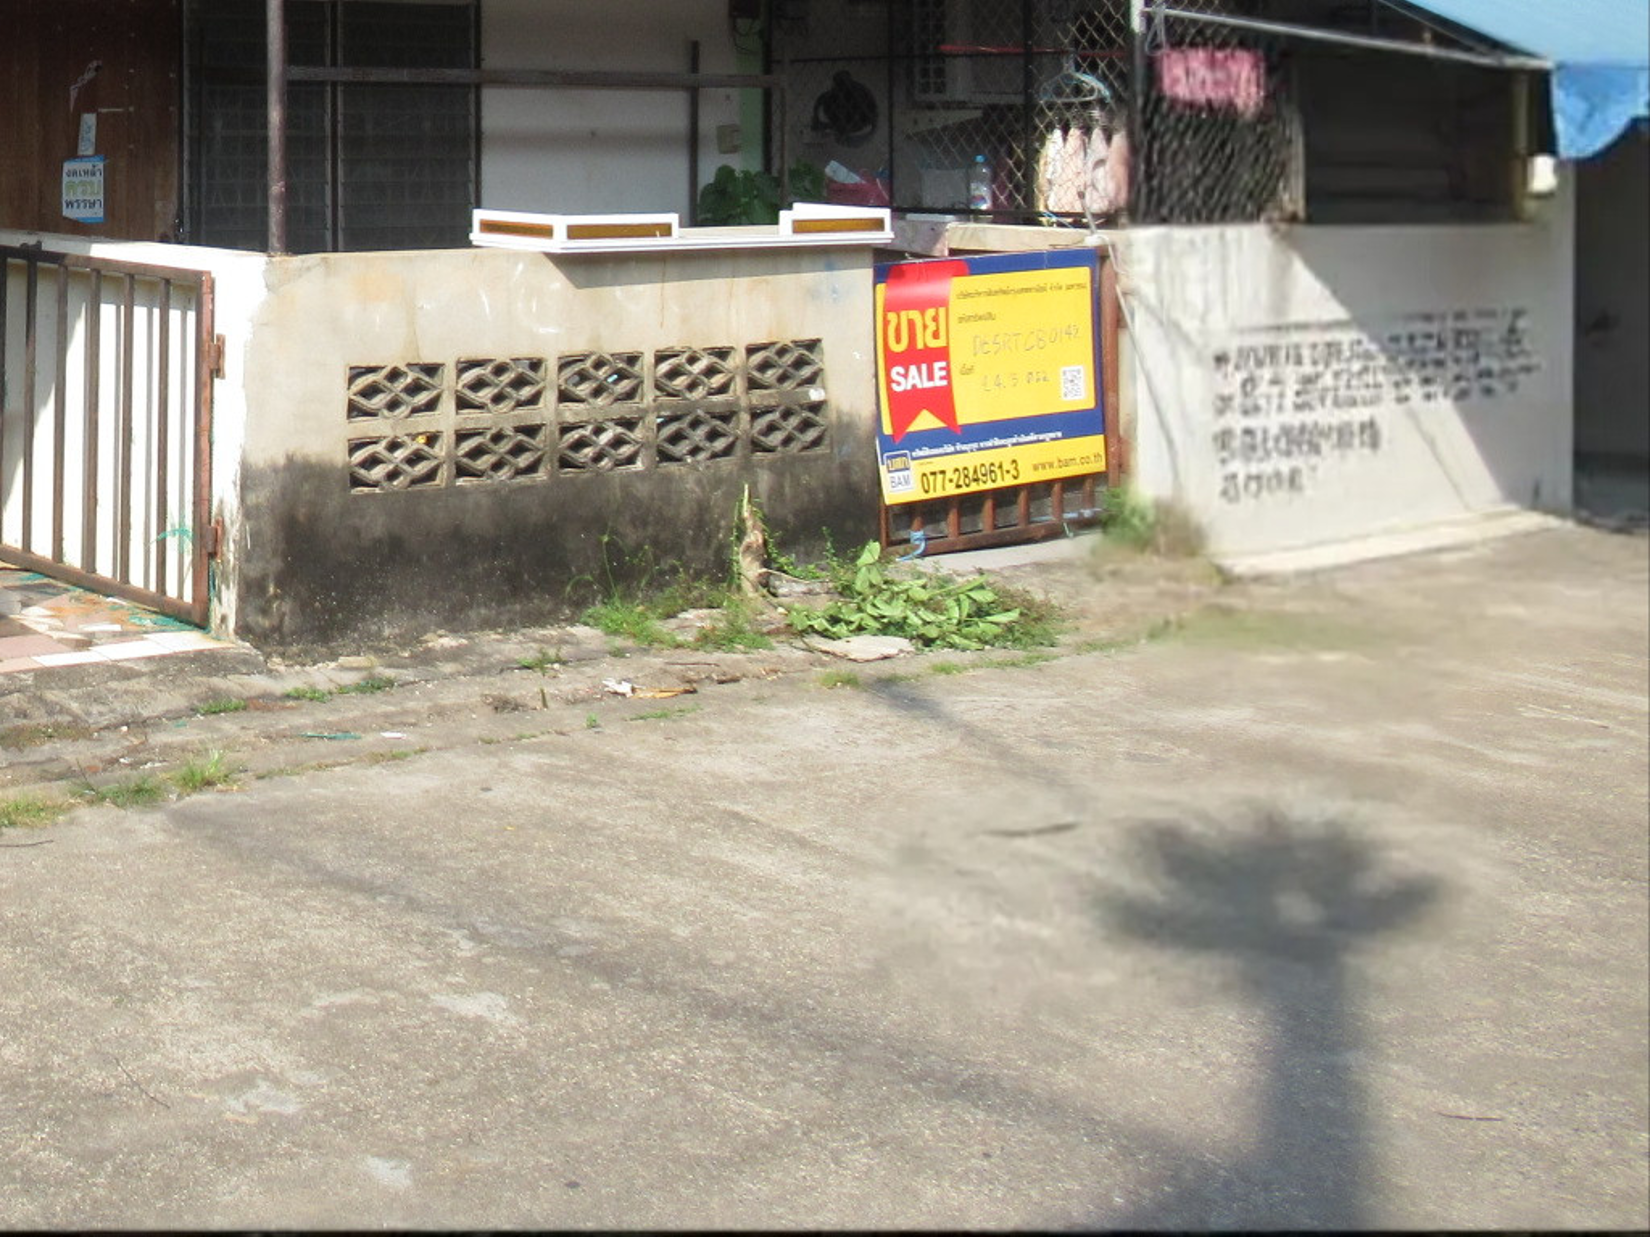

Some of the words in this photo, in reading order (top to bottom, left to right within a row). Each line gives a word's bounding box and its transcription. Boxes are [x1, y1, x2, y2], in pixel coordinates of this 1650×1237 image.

[65, 164, 102, 178] งดเหล้า
[65, 199, 102, 210] พรรษา
[887, 307, 947, 353] ขาย
[890, 361, 948, 392] SALE
[890, 473, 911, 489] BAM
[921, 459, 1021, 494] 077-284961-3
[1032, 453, 1103, 471] www.bam.co.th
